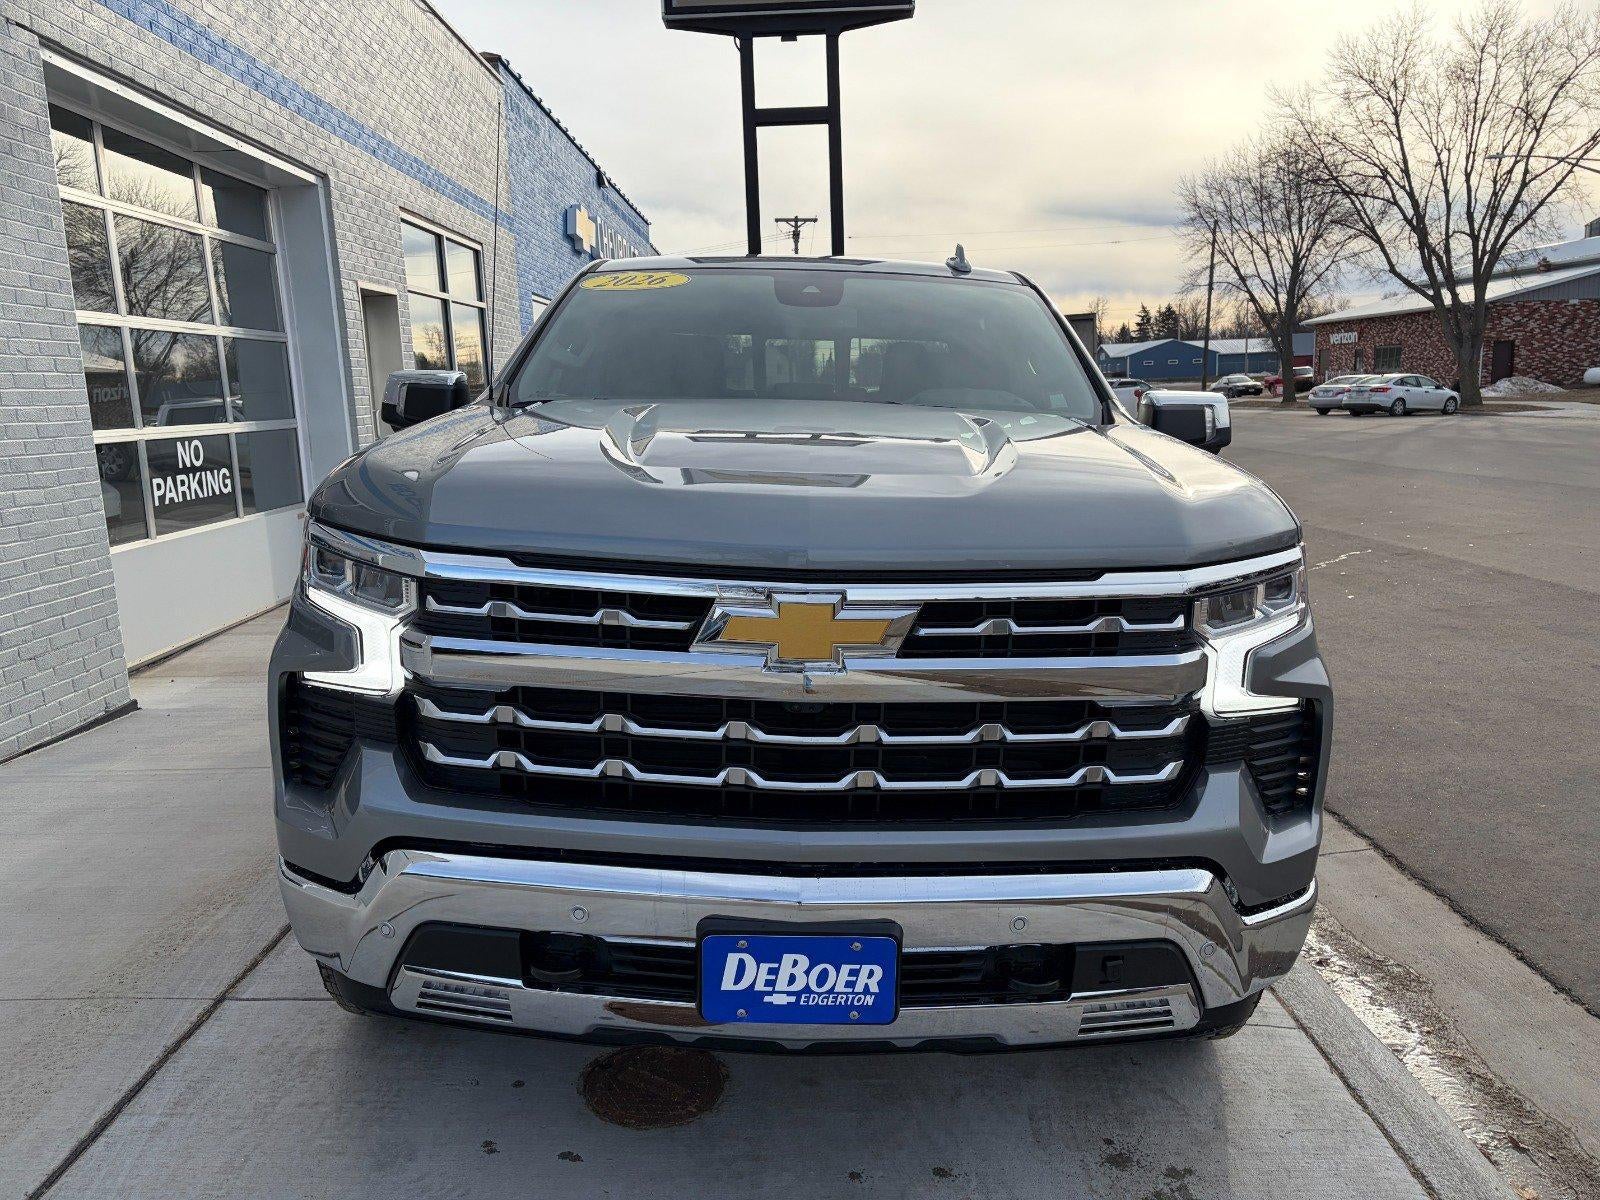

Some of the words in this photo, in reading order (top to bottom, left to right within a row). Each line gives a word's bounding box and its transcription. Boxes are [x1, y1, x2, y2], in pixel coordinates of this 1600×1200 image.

[593, 275, 668, 287] 2026
[1330, 332, 1358, 344] verizon
[176, 439, 204, 469] NO
[152, 468, 231, 506] PARKING
[800, 993, 875, 1006] EDGERTON
